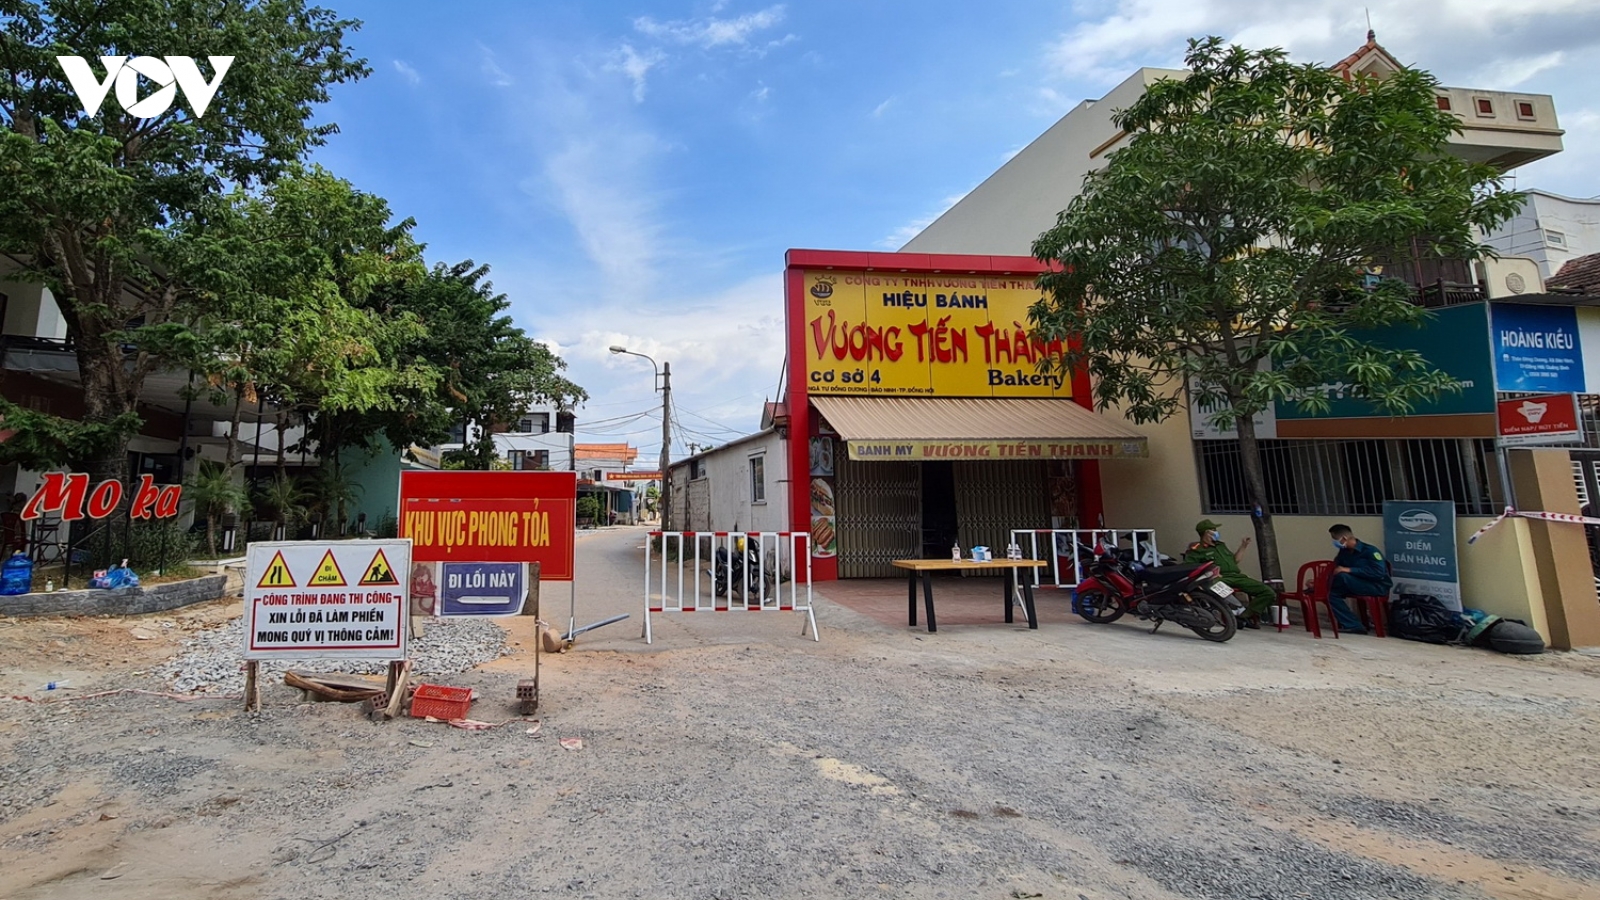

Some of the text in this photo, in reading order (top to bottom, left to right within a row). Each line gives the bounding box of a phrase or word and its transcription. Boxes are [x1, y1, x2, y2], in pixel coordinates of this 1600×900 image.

[883, 278, 897, 287] TY
[883, 290, 987, 310] HIỆU BÁNH
[810, 309, 903, 362] VƯƠNG
[907, 315, 968, 364] TIẾN
[1501, 327, 1543, 348] HOÀNG
[870, 369, 881, 384] 4
[987, 369, 1064, 390] Bakery
[922, 443, 990, 457] VƯƠNG
[997, 441, 1042, 456] TIẾN
[1048, 442, 1114, 456] THÀNH
[405, 497, 550, 554] KHU VỰC PHONG TỎA
[1415, 553, 1447, 566] HÀNG
[448, 567, 516, 589] ĐI LỐI NÀY
[262, 590, 392, 605] CÔNG TRÌNH ĐANG THI CÔNG
[268, 612, 287, 624] XIN
[290, 608, 306, 623] LỖI
[308, 609, 323, 623] ĐÃ
[326, 608, 349, 623] LÀM
[257, 626, 394, 644] MONG QUÝ VỊ THÔNG CẢM!
